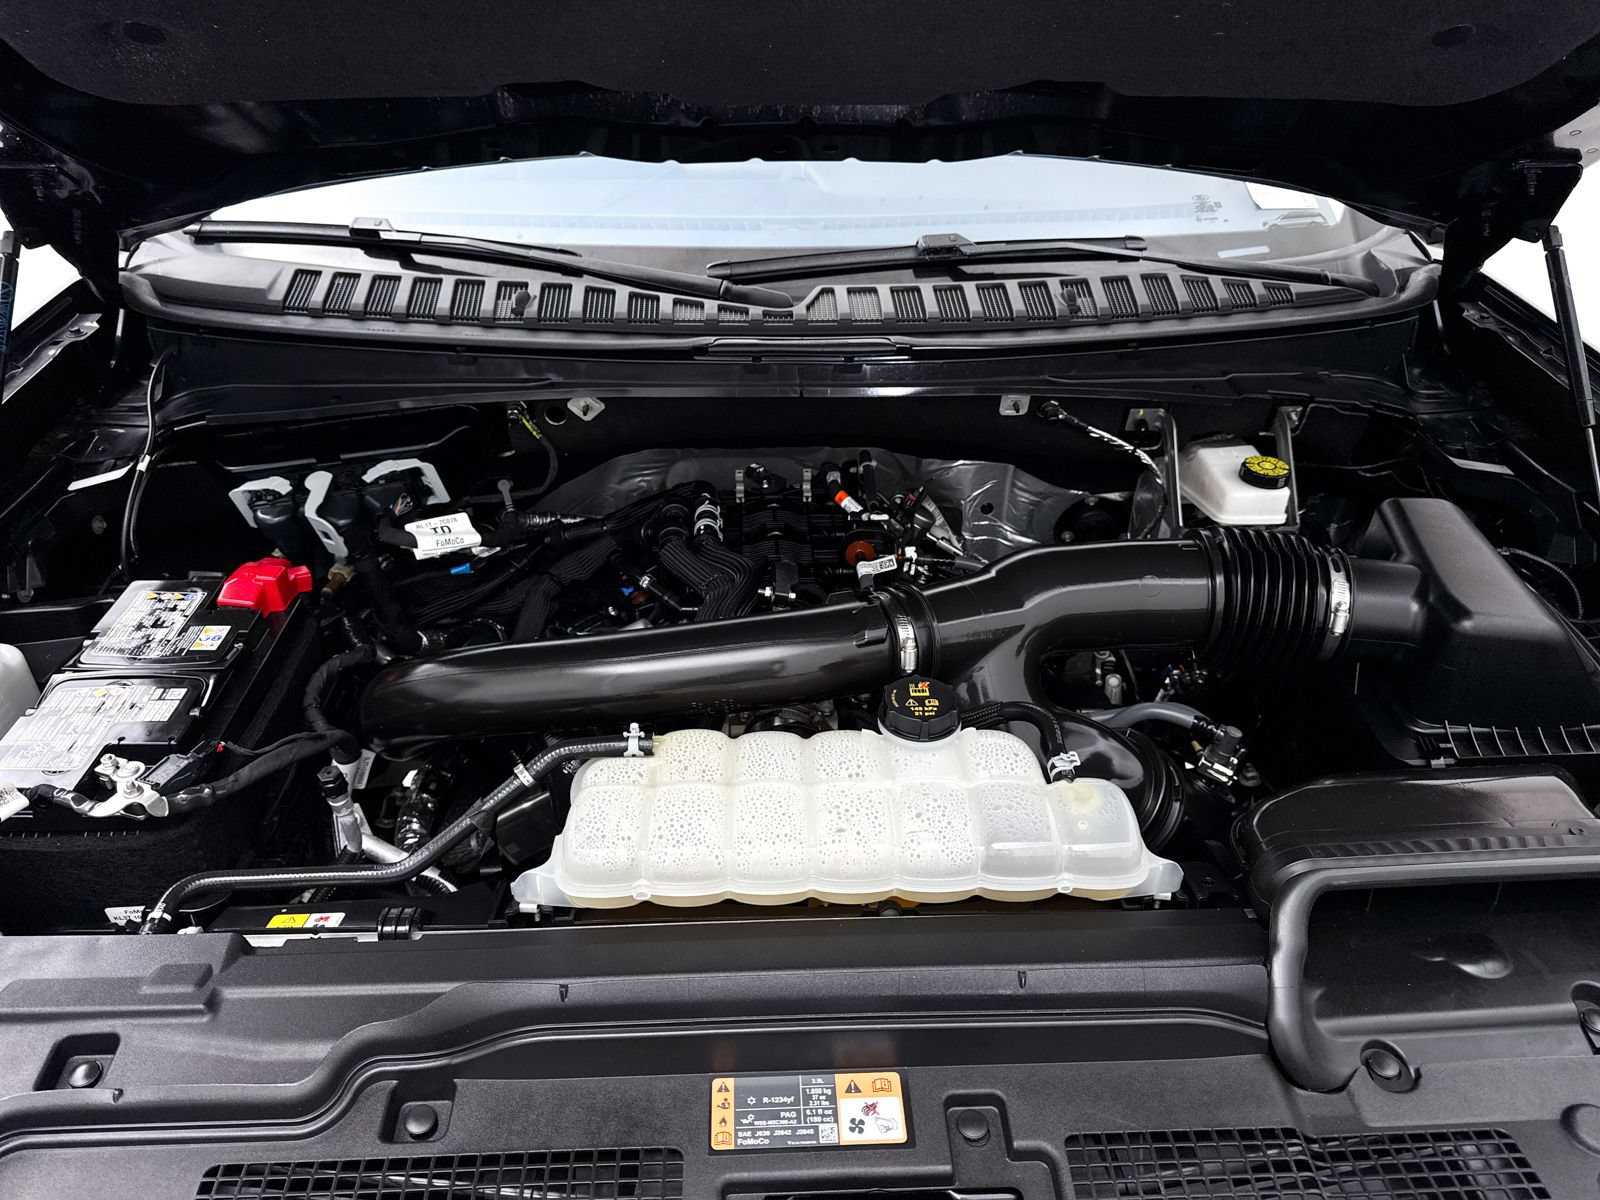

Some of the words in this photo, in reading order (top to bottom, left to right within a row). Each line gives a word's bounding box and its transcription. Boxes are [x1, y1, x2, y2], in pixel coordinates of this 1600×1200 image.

[436, 537, 465, 547] FoMoCo
[763, 1096, 795, 1104] R-1234yf
[737, 1138, 769, 1146] FoMoCo
